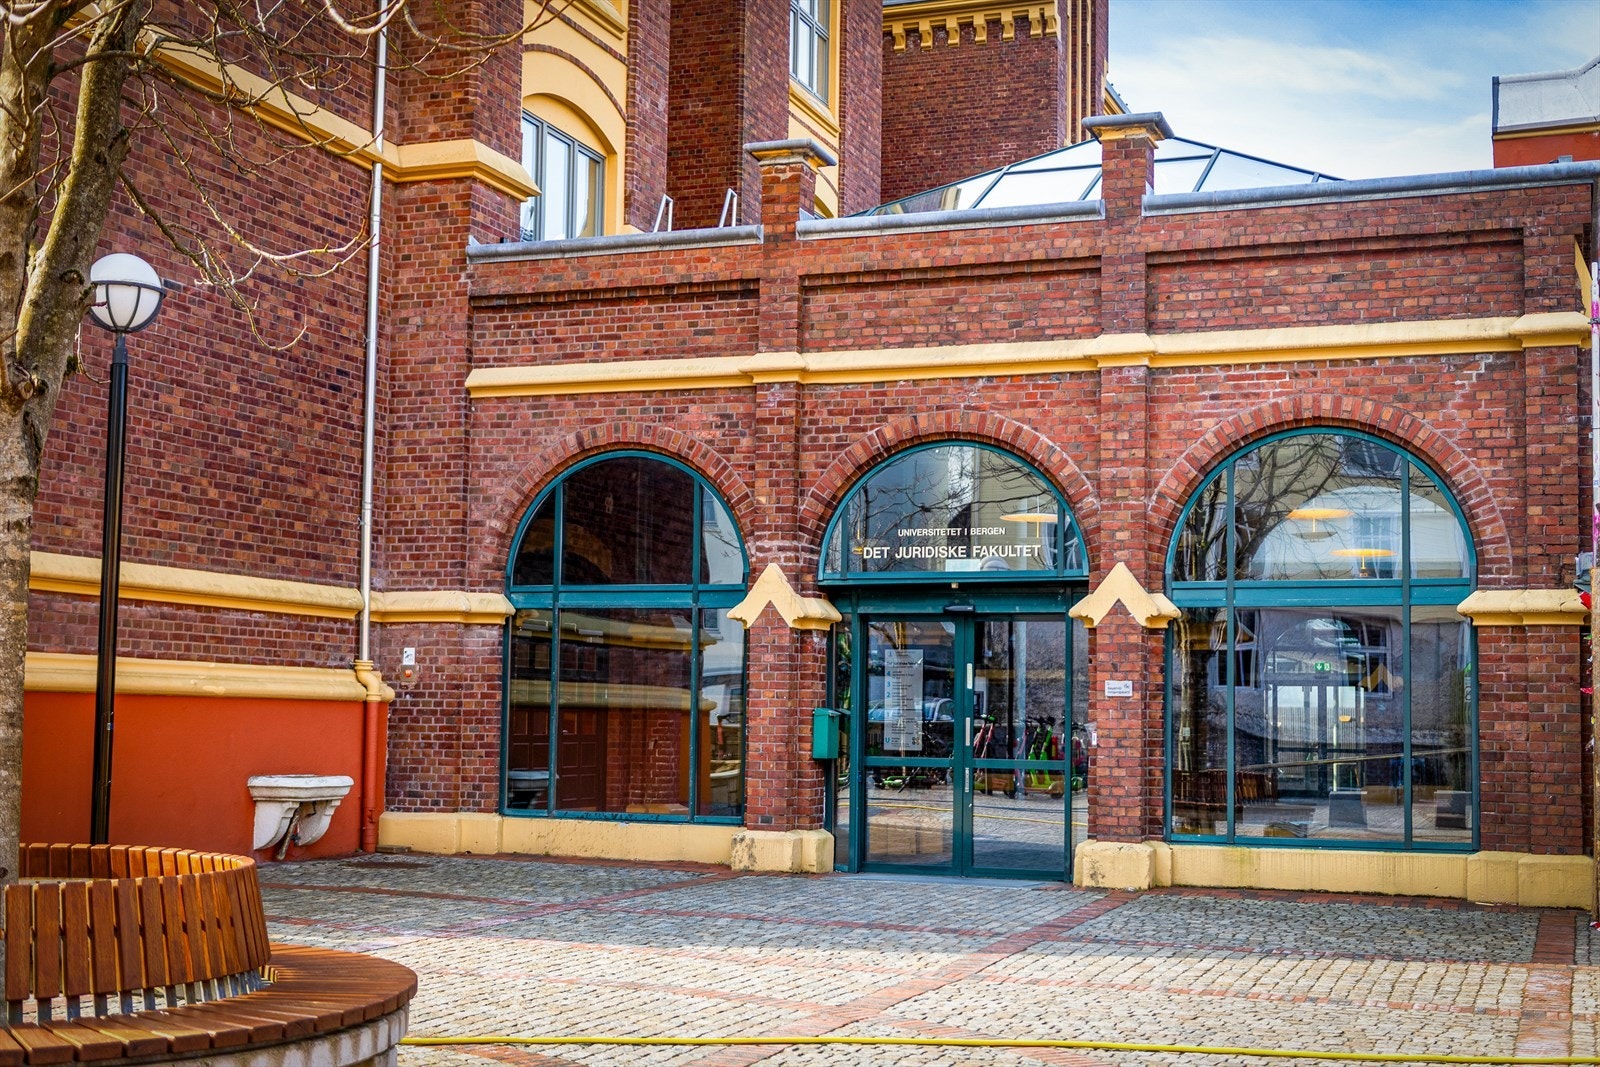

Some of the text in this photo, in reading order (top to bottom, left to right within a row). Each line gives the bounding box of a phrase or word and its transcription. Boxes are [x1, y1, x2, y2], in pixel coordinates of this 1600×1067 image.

[898, 528, 962, 537] UNIVERSITETET
[971, 527, 1006, 536] BERGEN
[863, 545, 1041, 559] DET JURIDISKE FAKULTET
